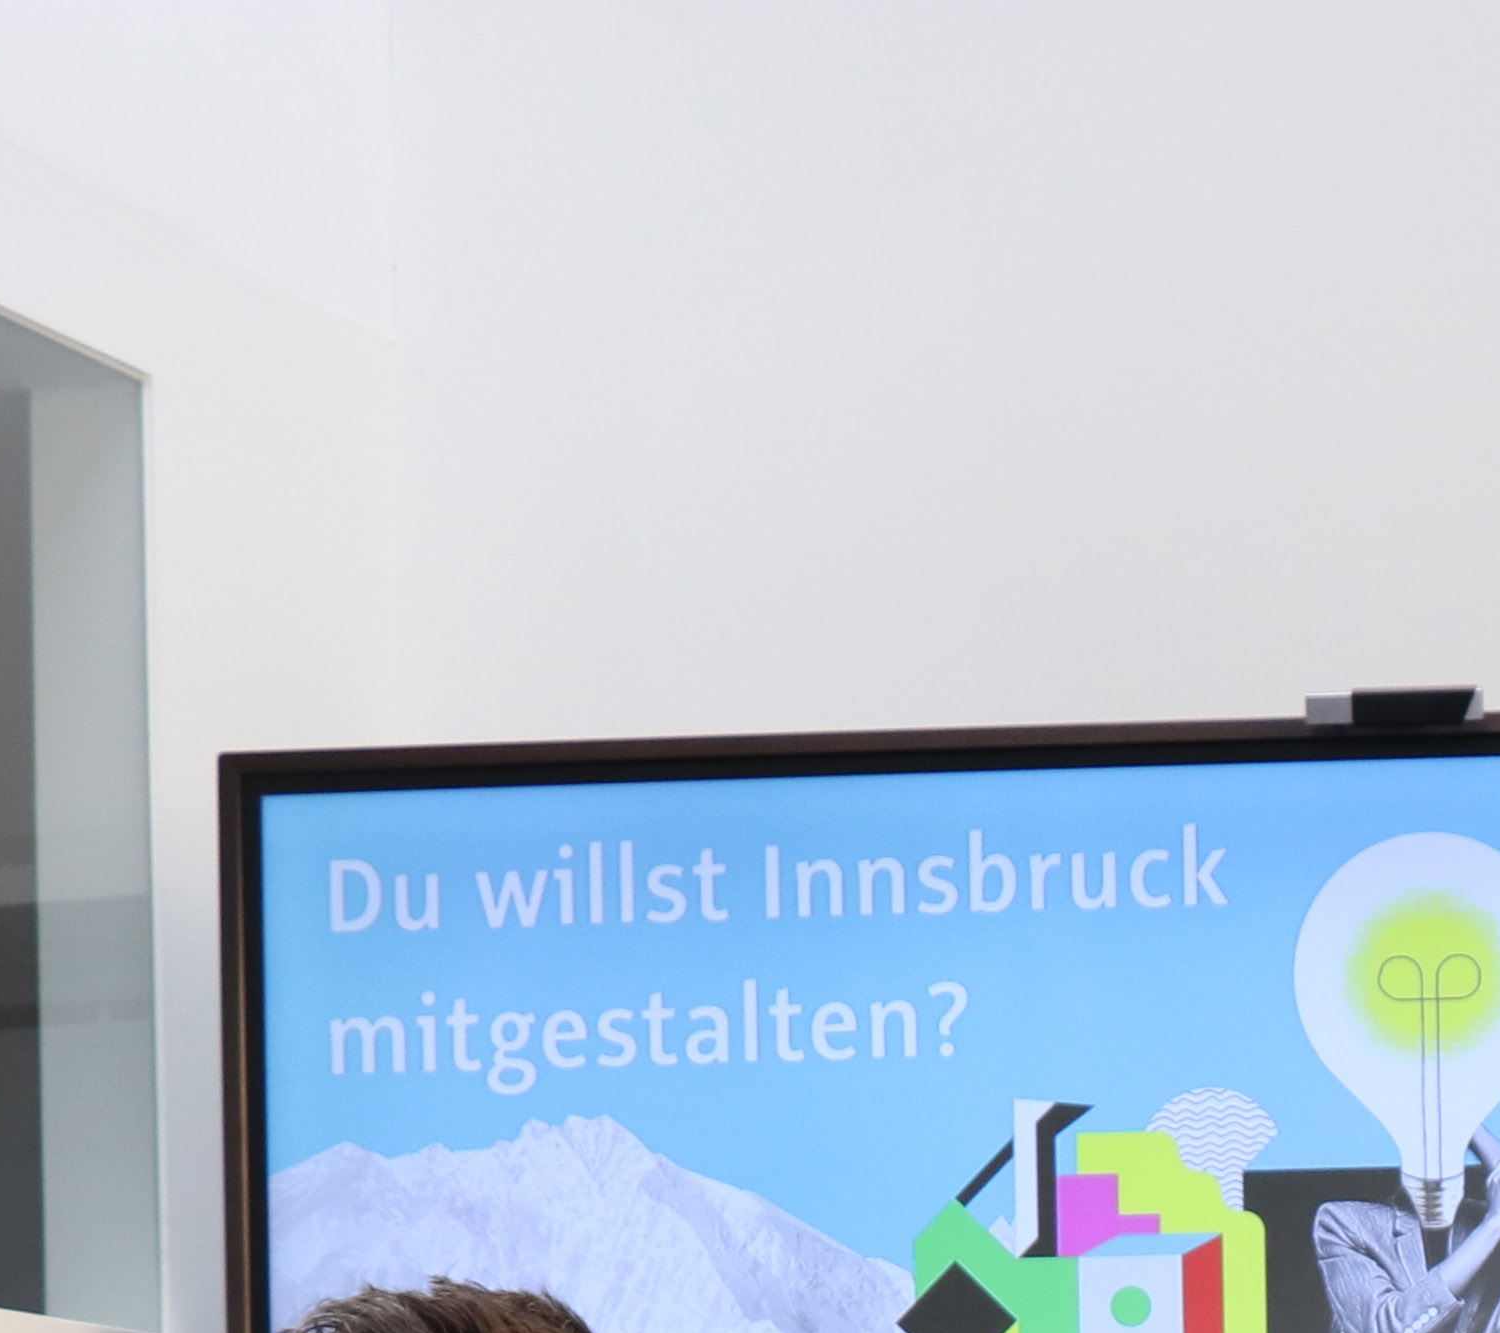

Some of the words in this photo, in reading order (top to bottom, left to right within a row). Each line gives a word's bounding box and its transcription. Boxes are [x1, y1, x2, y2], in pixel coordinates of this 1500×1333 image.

[329, 858, 440, 934] Du
[475, 840, 729, 929] willst
[764, 822, 1229, 920] Innsbruck
[329, 978, 969, 1096] mitgestalten?
